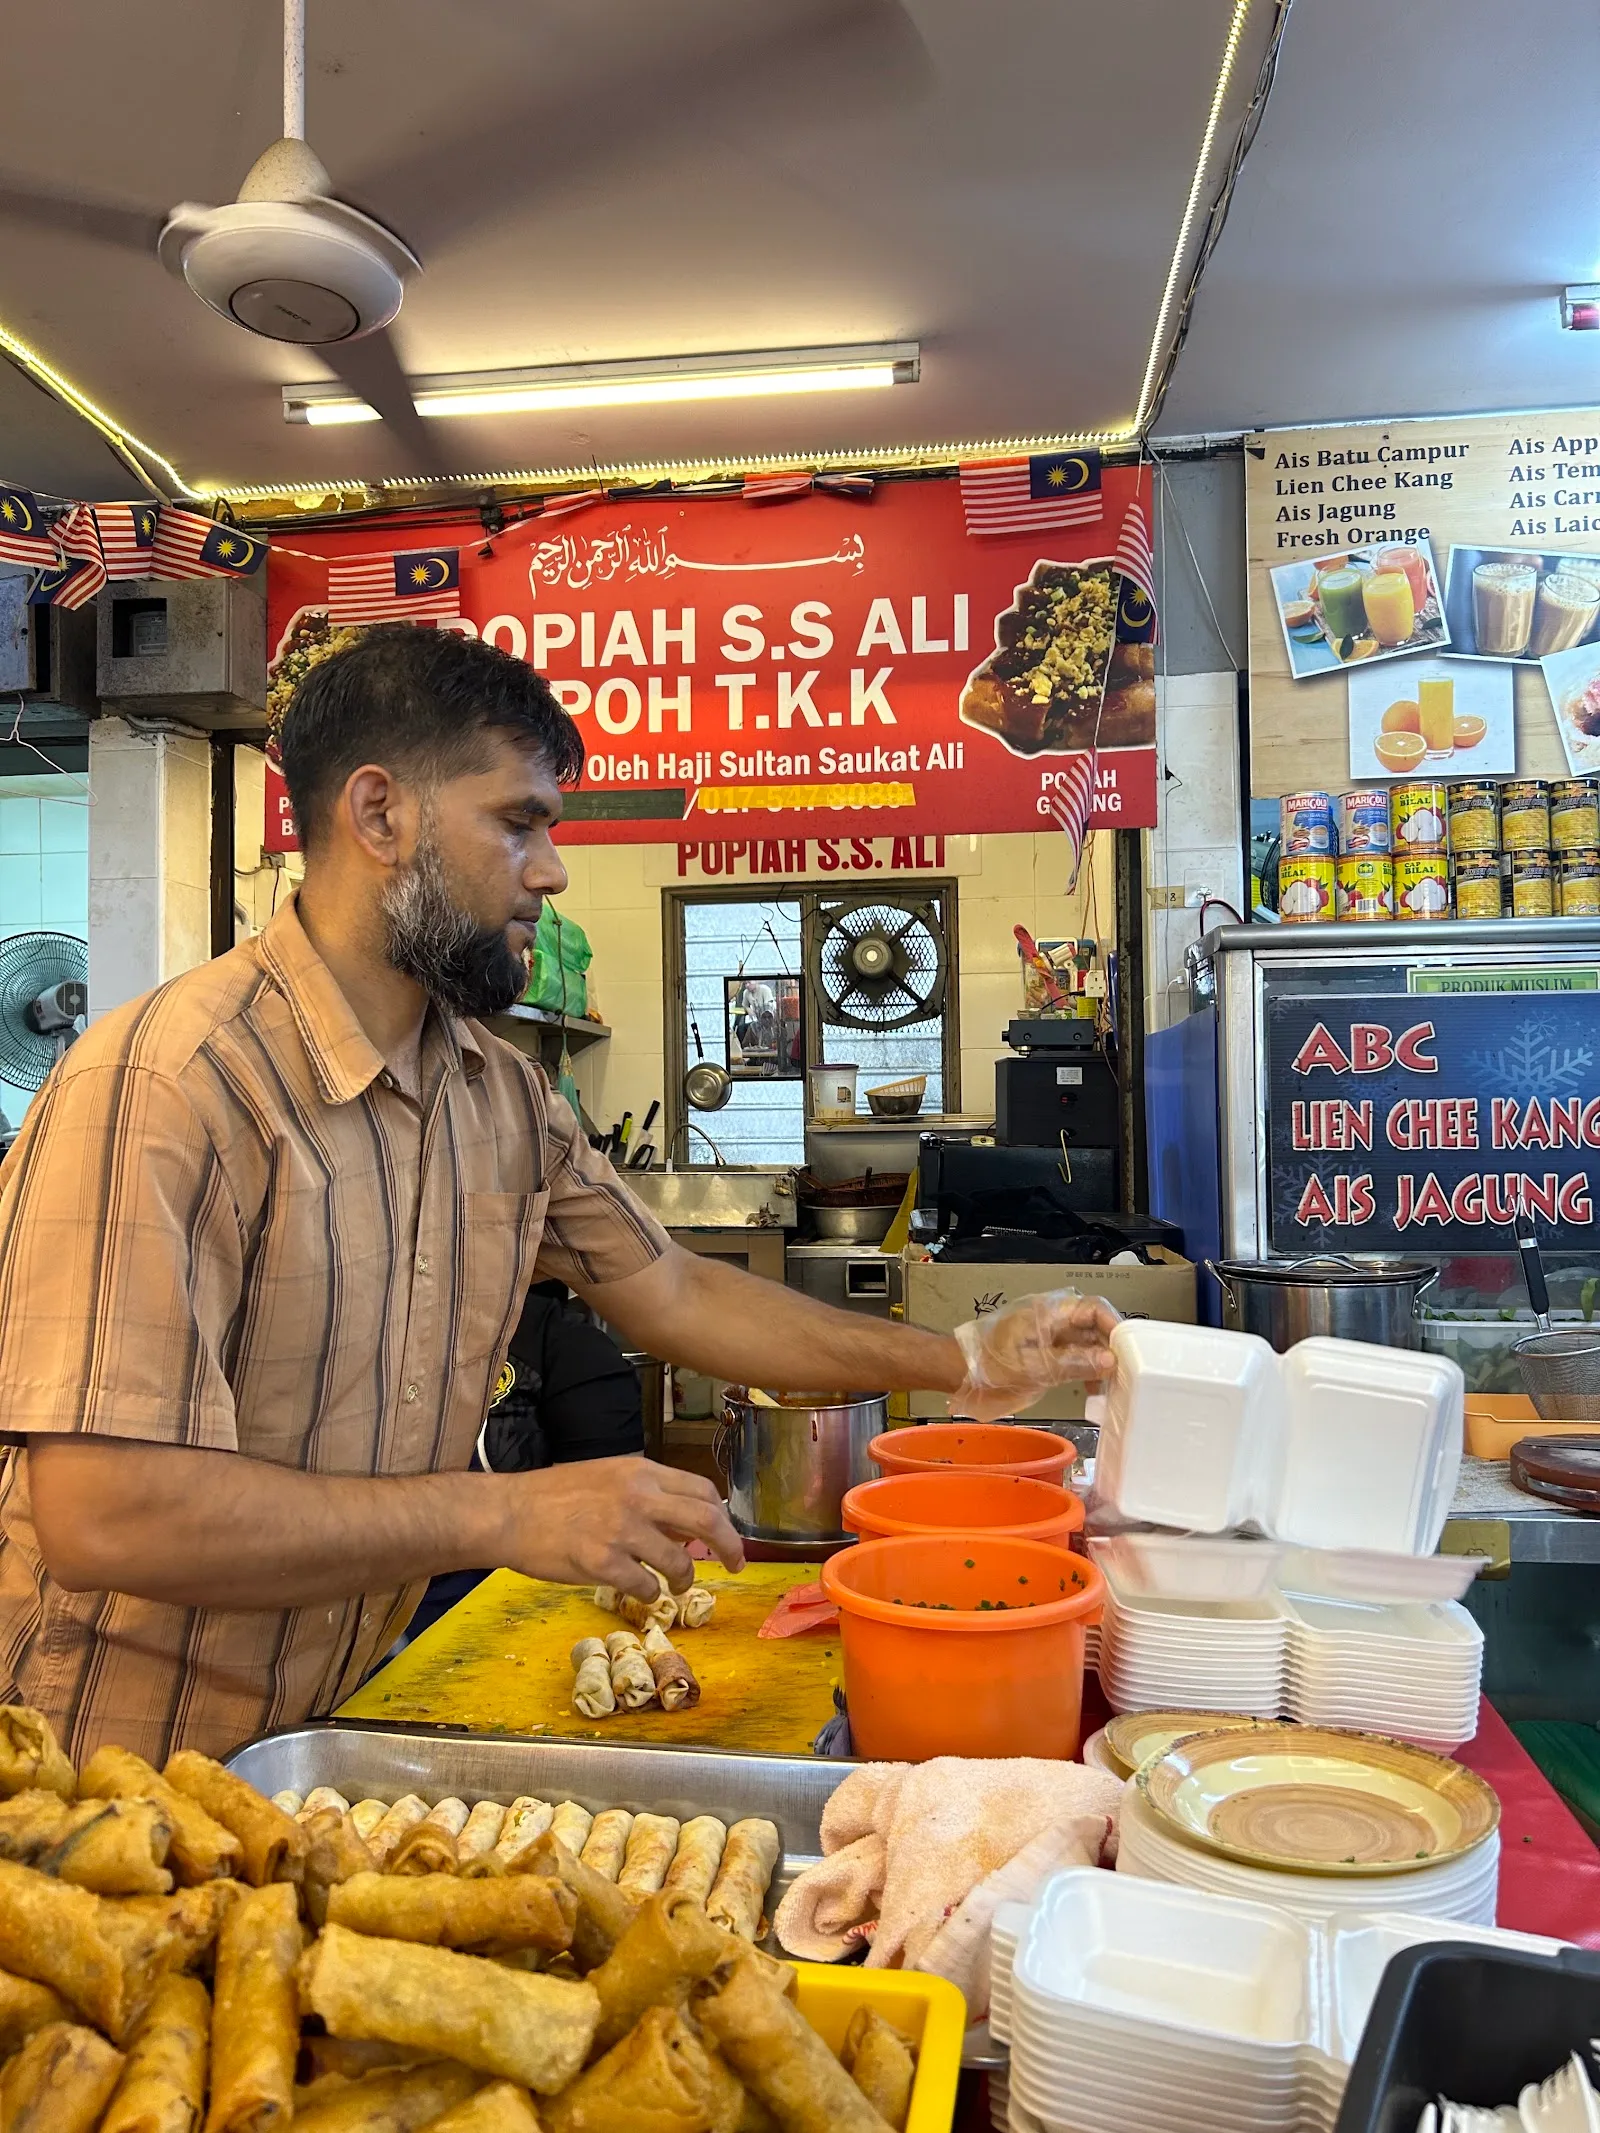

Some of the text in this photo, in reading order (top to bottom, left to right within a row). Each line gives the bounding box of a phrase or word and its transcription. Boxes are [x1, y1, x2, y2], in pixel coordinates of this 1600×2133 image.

[1274, 442, 1470, 470] Ais Batu Campur
[1508, 438, 1545, 456] Ais
[1276, 470, 1454, 496] Lien Chee Kang
[1508, 465, 1546, 483] Ais
[1509, 491, 1547, 509] Ais
[1276, 501, 1396, 524] Ais Jagung
[1276, 525, 1431, 548] Fresh Orange
[1509, 518, 1547, 536] Ais
[719, 600, 835, 663] S.S
[855, 593, 970, 657] ALI
[714, 666, 899, 731] T.K.K
[587, 742, 965, 785] Oleh Haji Sultan Saukat Ali
[1400, 797, 1431, 807] BILAL
[677, 835, 946, 877] POPIAH S.S. ALI
[1404, 861, 1421, 869] CAP
[1404, 865, 1436, 875] BILAL
[1440, 977, 1573, 993] PRODUK MUSLIM
[1290, 1020, 1439, 1076] ABC
[1291, 1096, 1600, 1151] LIEN CHEE KANG
[1294, 1171, 1594, 1231] AIS JAGUNG
